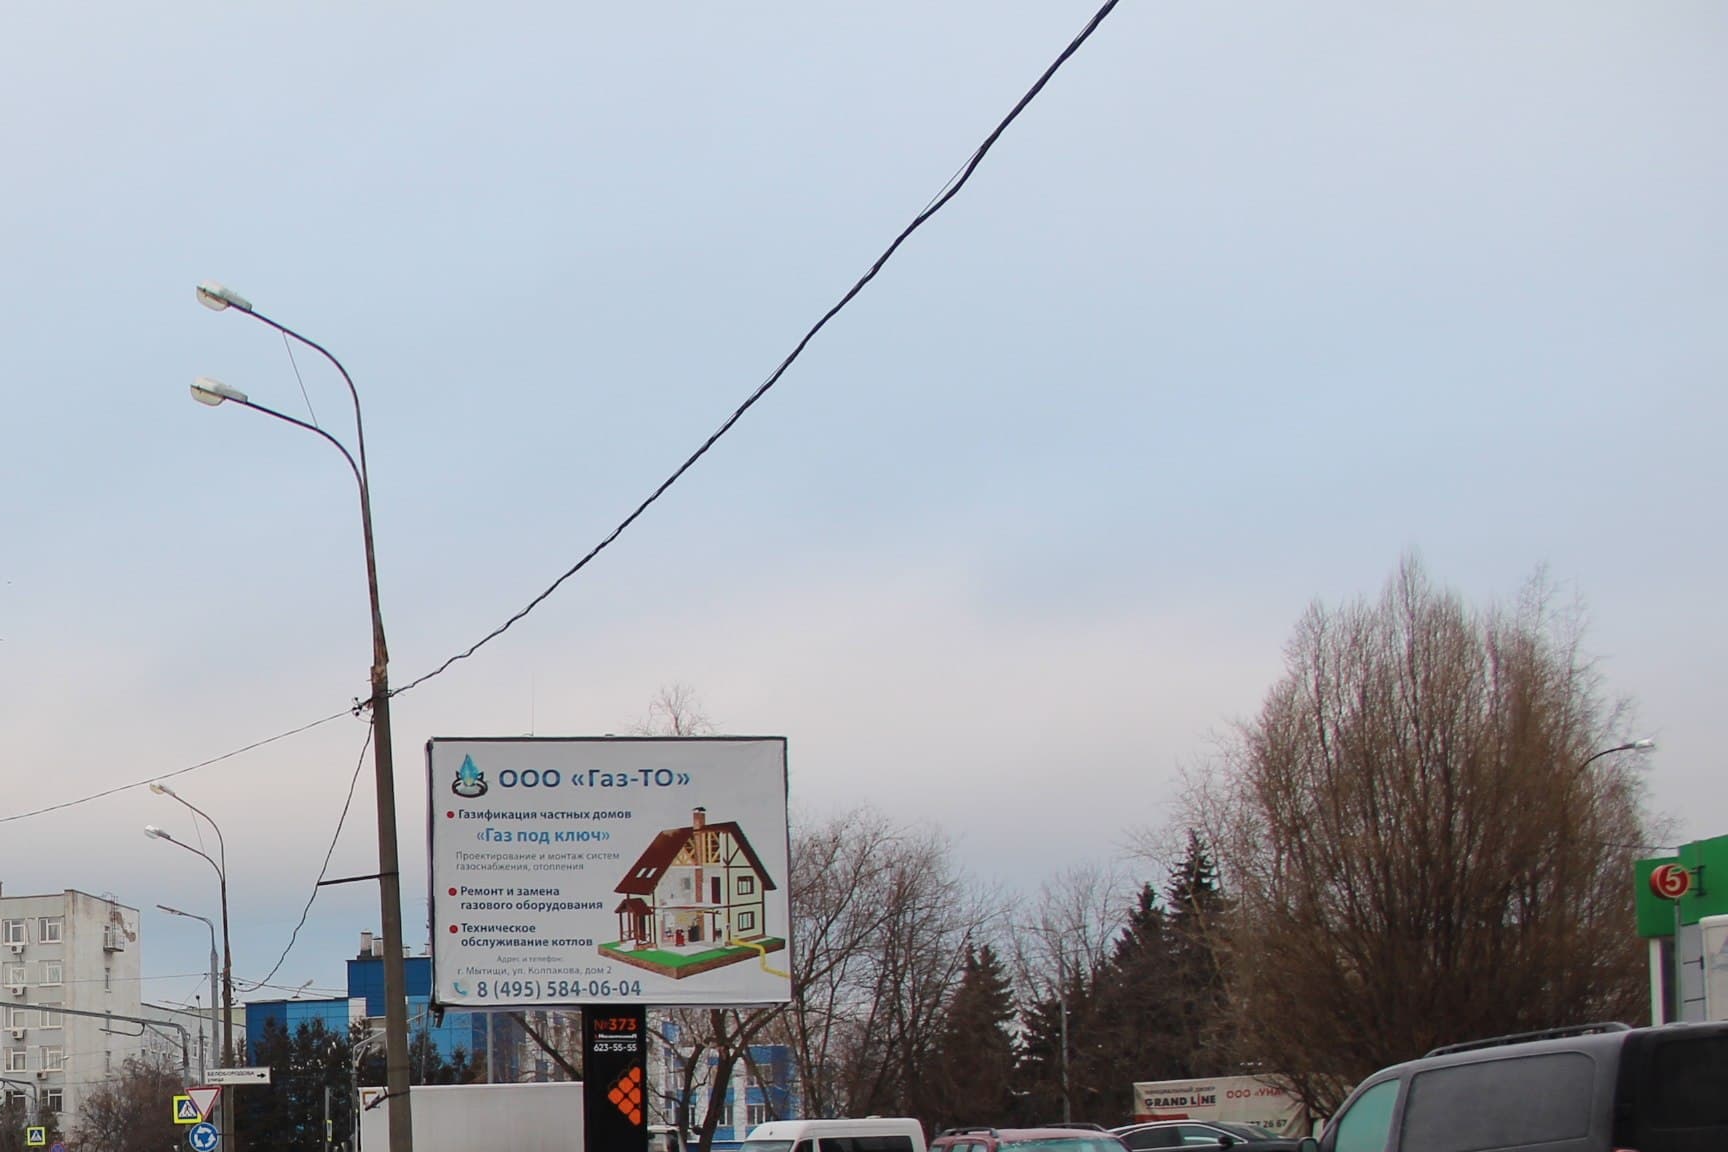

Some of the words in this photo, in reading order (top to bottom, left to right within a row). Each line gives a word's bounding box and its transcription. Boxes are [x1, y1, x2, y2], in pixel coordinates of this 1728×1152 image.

[498, 769, 561, 788] ООО
[571, 768, 691, 788] «Газ-ТО»
[458, 809, 537, 822] Газификация
[540, 810, 590, 820] частных
[592, 810, 632, 820] домов
[476, 828, 512, 842] «Газ
[517, 830, 550, 844] под
[555, 830, 610, 842] ключ»
[455, 851, 537, 862] Проектирование
[548, 852, 584, 860] монтаж
[586, 851, 621, 860] систем
[455, 862, 530, 872] газоснабжения,
[533, 862, 584, 871] отопления
[460, 886, 504, 897] Ремонт
[506, 888, 514, 896] и
[516, 887, 560, 896] замена
[460, 901, 513, 910] газового
[516, 901, 603, 912] оборудования
[461, 923, 536, 933] Техническое
[461, 936, 549, 949] обслуживание
[551, 938, 593, 947] котлов
[466, 967, 510, 977] Мытищи,
[585, 967, 604, 976] дом
[477, 981, 488, 998] 8
[494, 980, 541, 999] (495)
[547, 980, 642, 997] 584-06-04
[593, 1043, 638, 1052] 623-55-55
[1226, 1089, 1251, 1099] ООО
[1144, 1096, 1187, 1106] GRAND
